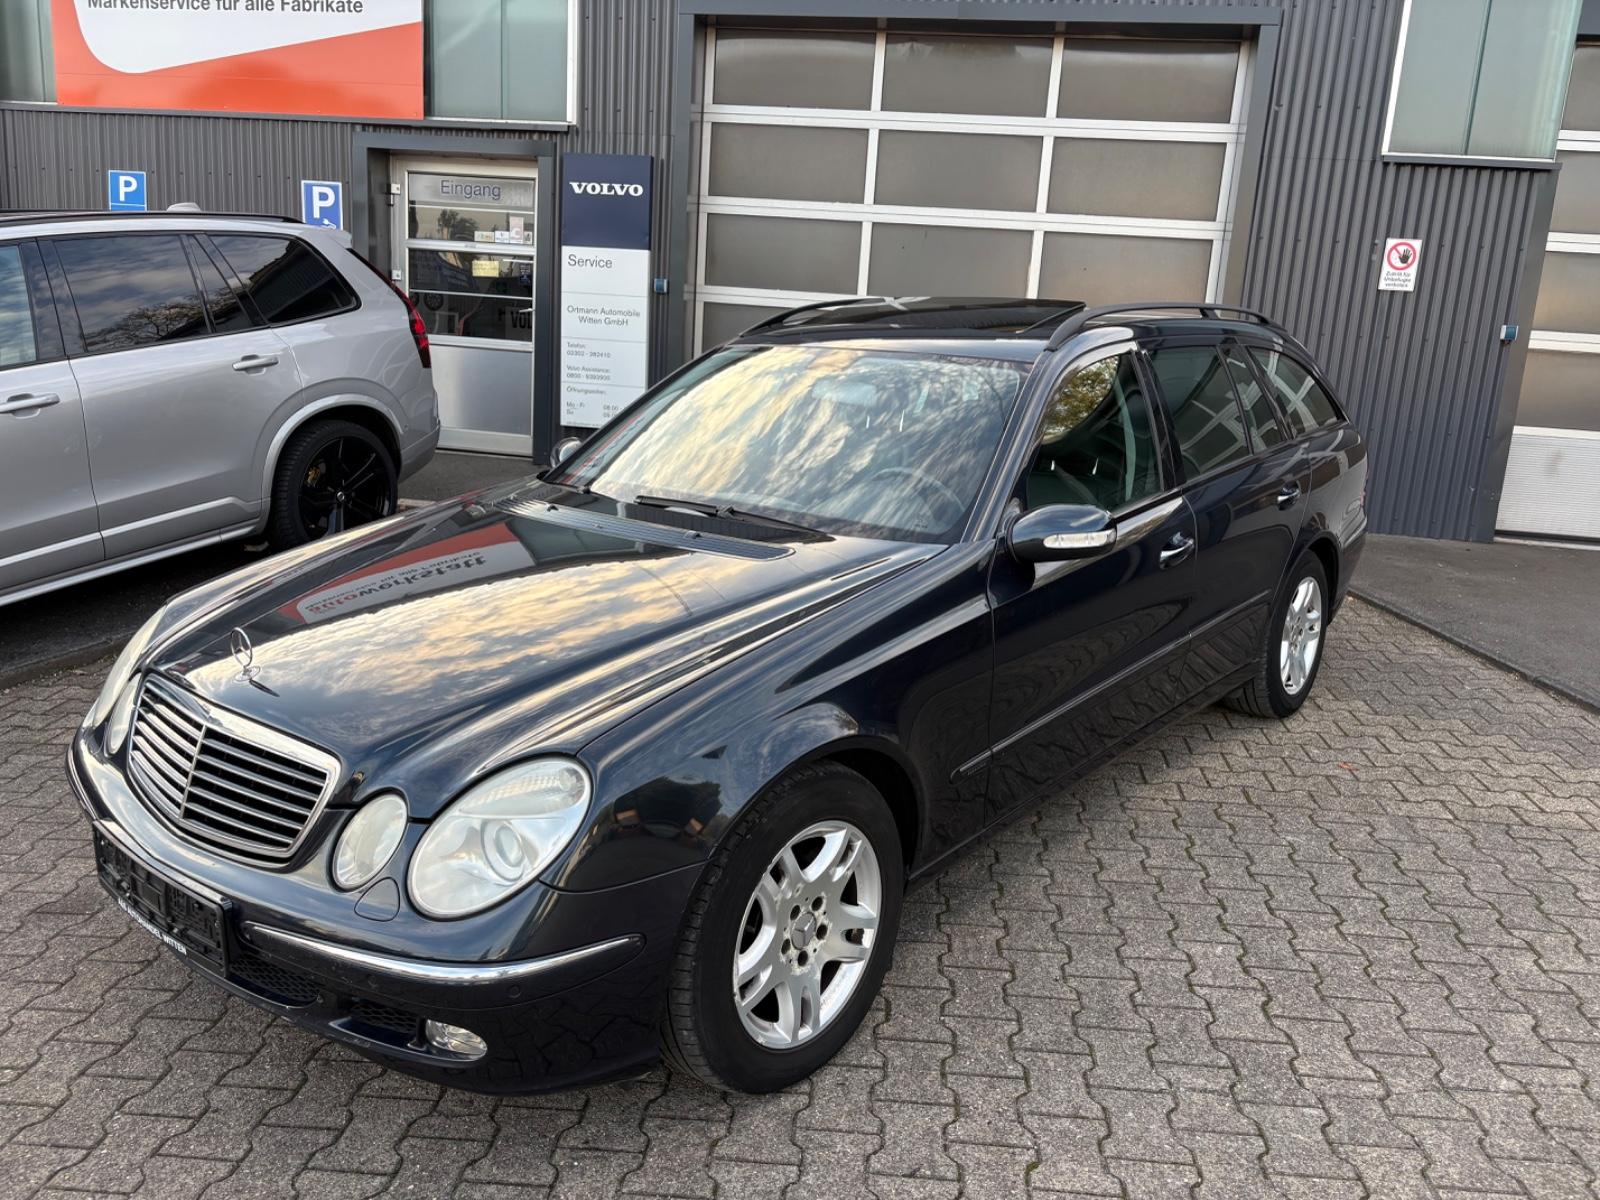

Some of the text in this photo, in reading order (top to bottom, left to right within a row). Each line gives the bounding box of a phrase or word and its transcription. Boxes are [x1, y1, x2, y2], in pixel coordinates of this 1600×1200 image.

[87, 0, 211, 11] Markenservice
[244, 0, 275, 11] alle
[280, 0, 364, 13] Fabrikate
[119, 175, 138, 202] P
[440, 179, 501, 199] Eingang
[569, 182, 644, 197] VOLVO
[312, 185, 336, 219] P
[567, 253, 613, 269] Service
[567, 305, 599, 315] Ortmann
[578, 315, 629, 326] Witten GmbH
